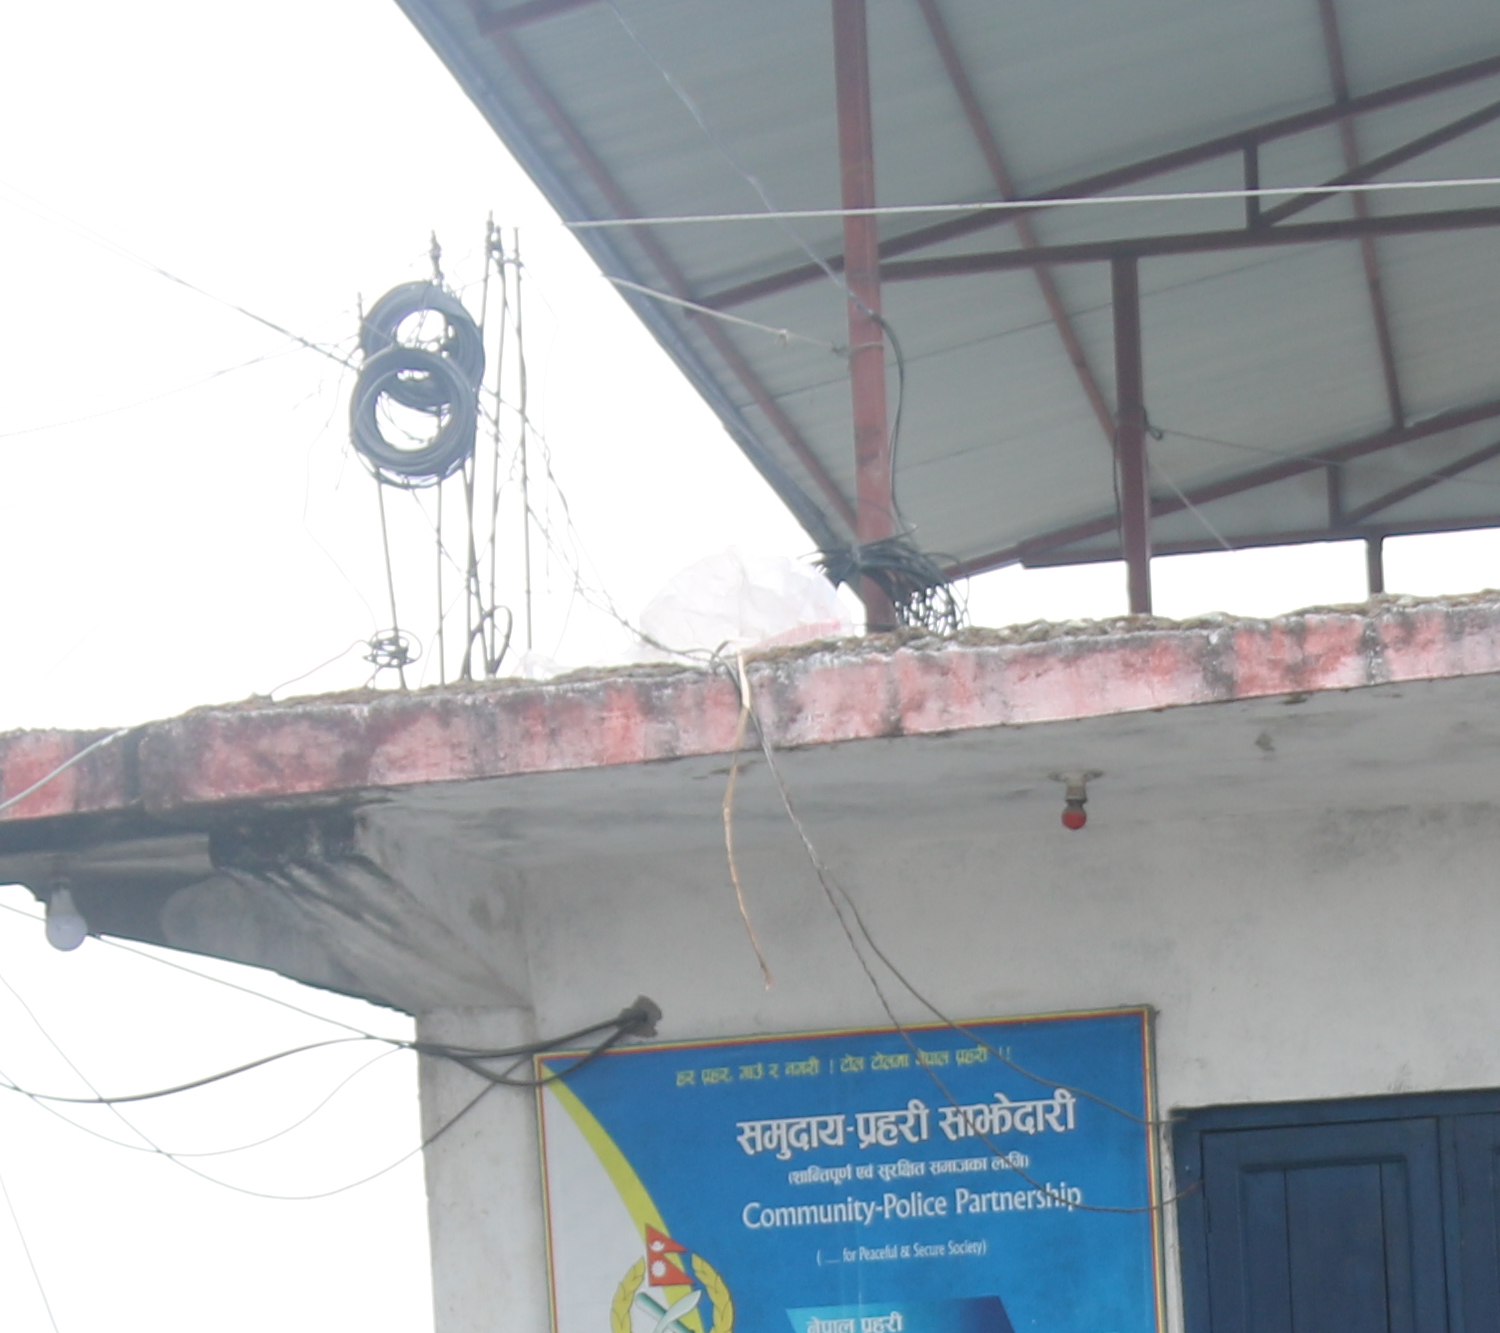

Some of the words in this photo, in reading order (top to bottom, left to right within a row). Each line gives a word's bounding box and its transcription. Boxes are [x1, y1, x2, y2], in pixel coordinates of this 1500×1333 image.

[736, 1099, 929, 1161] समुदाय-प्रहरी
[938, 1088, 1076, 1141] साझेदारी
[742, 1193, 948, 1229] Community-Police
[956, 1182, 1082, 1214] Partnership
[842, 1246, 857, 1263] for
[859, 1244, 899, 1262] Peaceful
[913, 1241, 946, 1258] Secure
[948, 1239, 987, 1257] Society)
